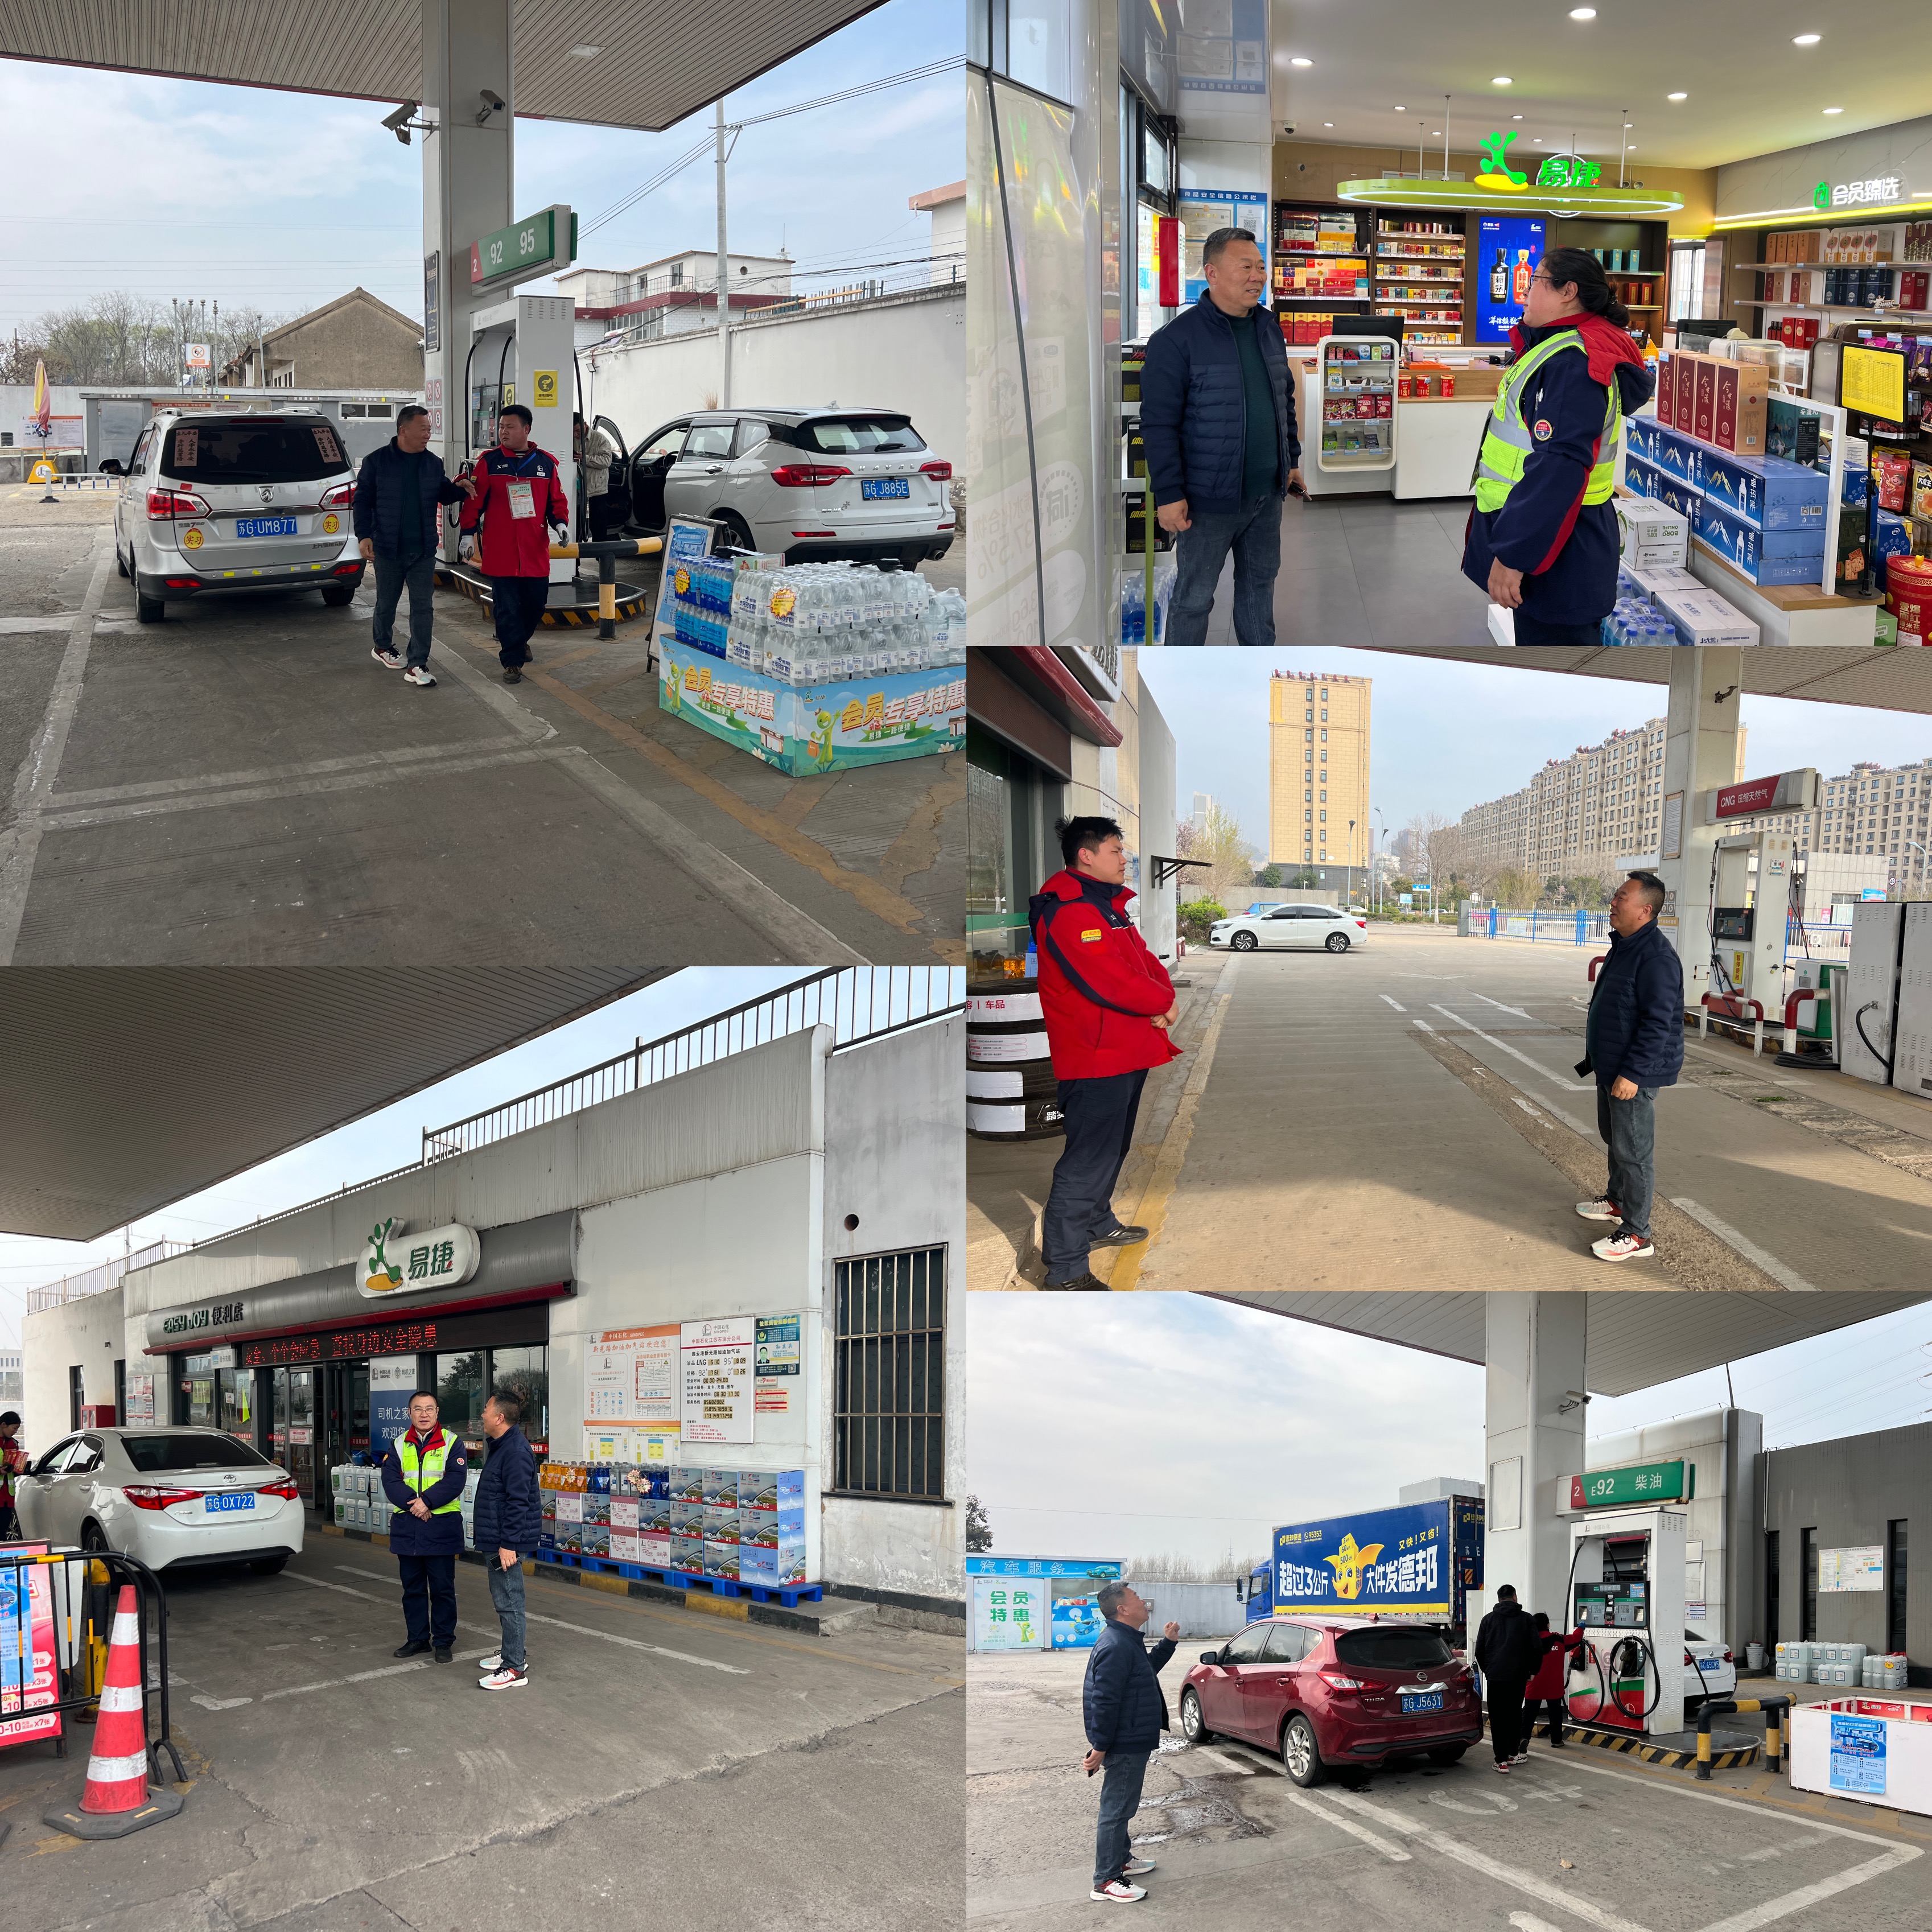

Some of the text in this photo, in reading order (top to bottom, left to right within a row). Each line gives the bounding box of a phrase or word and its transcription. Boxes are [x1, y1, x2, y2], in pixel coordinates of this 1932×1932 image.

[1538, 159, 1602, 188] 易捷
[1184, 191, 1257, 200] 食品安全信息公示栏
[1832, 176, 1900, 205] 会员臻选
[473, 228, 535, 273] 2 92 95
[858, 463, 915, 472] HAVAL
[864, 481, 908, 496] 苏G·J885E
[238, 519, 296, 535] 苏G·UM877
[324, 521, 339, 530] 实习
[186, 535, 203, 545] 实习
[701, 701, 731, 717] 易捷 一路便捷
[868, 723, 912, 741] 易捷 一路便捷
[1720, 788, 1785, 808] CNG 压缩天然气 7
[985, 999, 1006, 1010] 车品
[408, 1241, 455, 1281] 易捷
[163, 1302, 245, 1334] EASY JOY 便利店
[691, 1335, 741, 1344] 中国石化江苏石油分公司
[691, 1348, 740, 1357] 连云港新光路加油加气站
[378, 1407, 411, 1421] 司机之家
[1573, 1472, 1663, 1497] 2 E92 柴油
[1285, 1533, 1302, 1543] 德邦快递
[1308, 1529, 1323, 1538] 95353
[979, 1560, 1065, 1575] 汽车服务
[1366, 1544, 1438, 1594] 大件发德邦
[1279, 1560, 1329, 1597] 超过3公斤
[990, 1590, 1029, 1605] 会员
[990, 1608, 1029, 1622] 特惠
[1403, 1694, 1442, 1710] 苏G·J563Y
